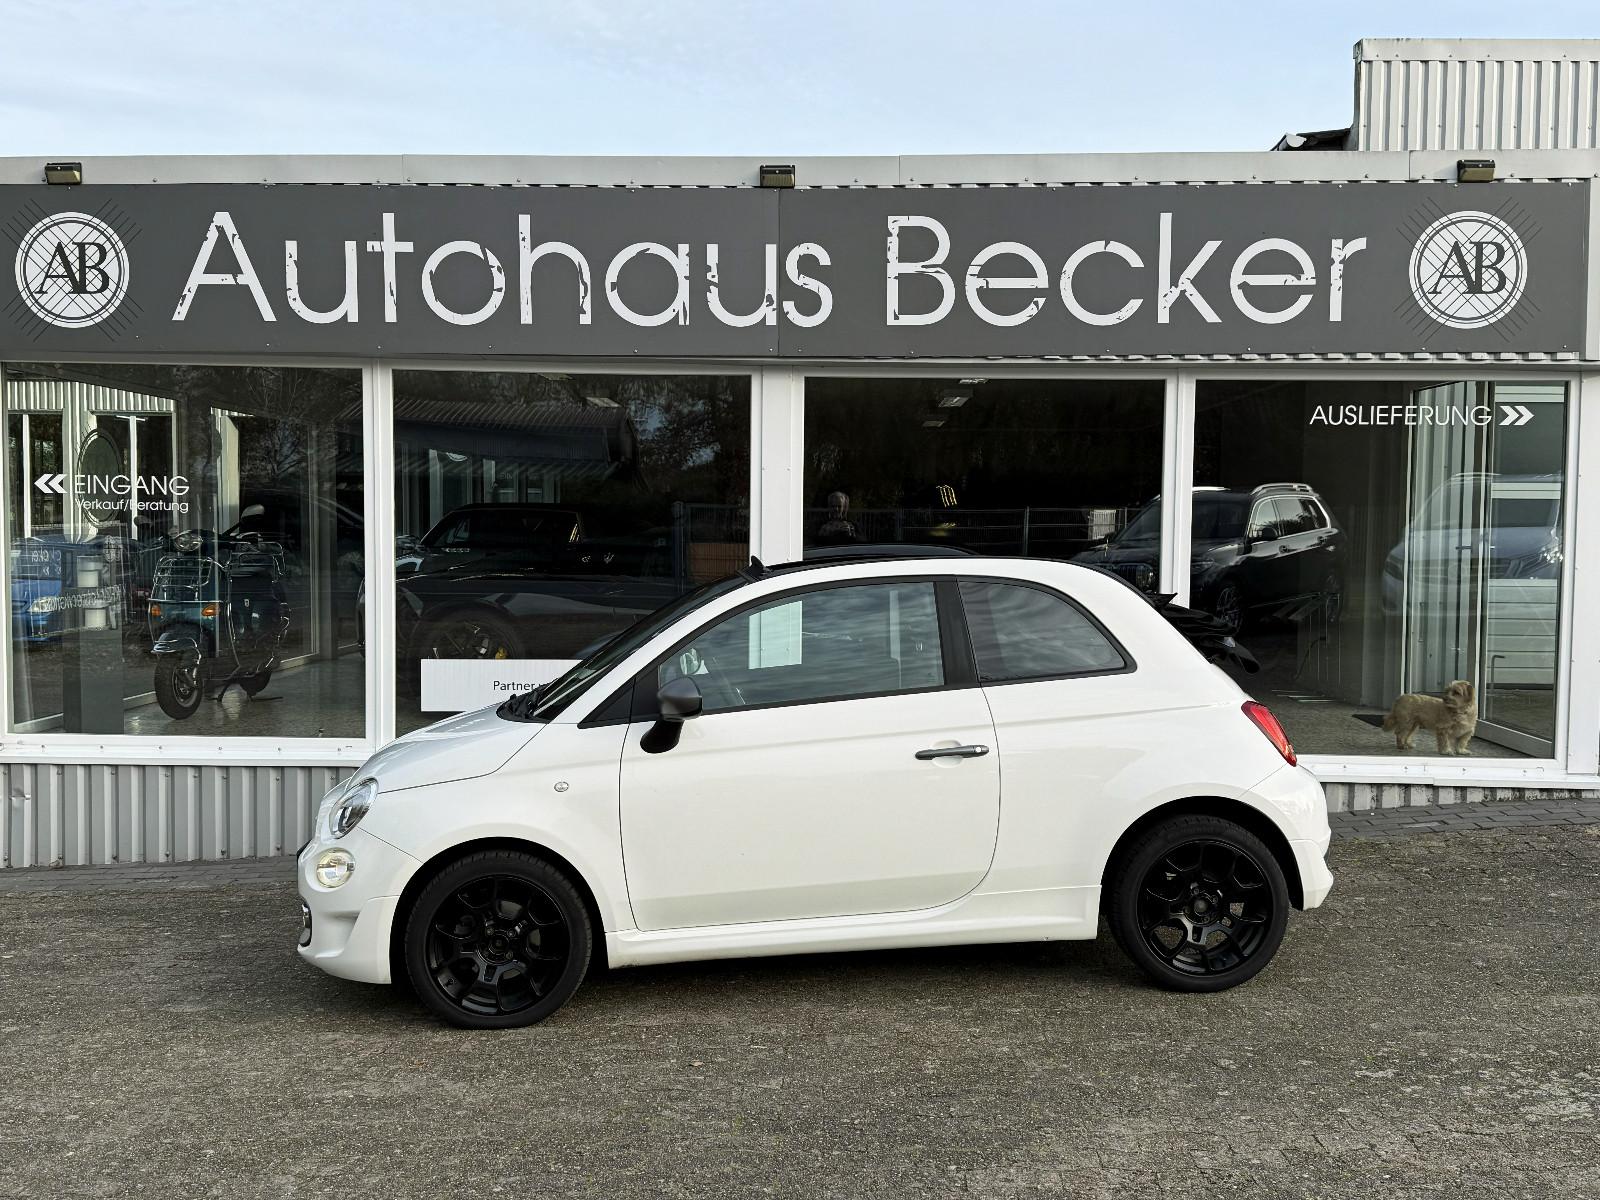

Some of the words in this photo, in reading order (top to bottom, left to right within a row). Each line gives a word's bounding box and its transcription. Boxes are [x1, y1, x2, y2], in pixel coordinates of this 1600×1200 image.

[34, 241, 110, 295] AB
[172, 211, 833, 328] Autohaus
[886, 212, 1367, 328] Becker
[1427, 240, 1507, 295] AB
[1309, 404, 1493, 426] AUSLIEFERUNG
[74, 474, 190, 496] EINGANG
[493, 680, 535, 691] Partner
